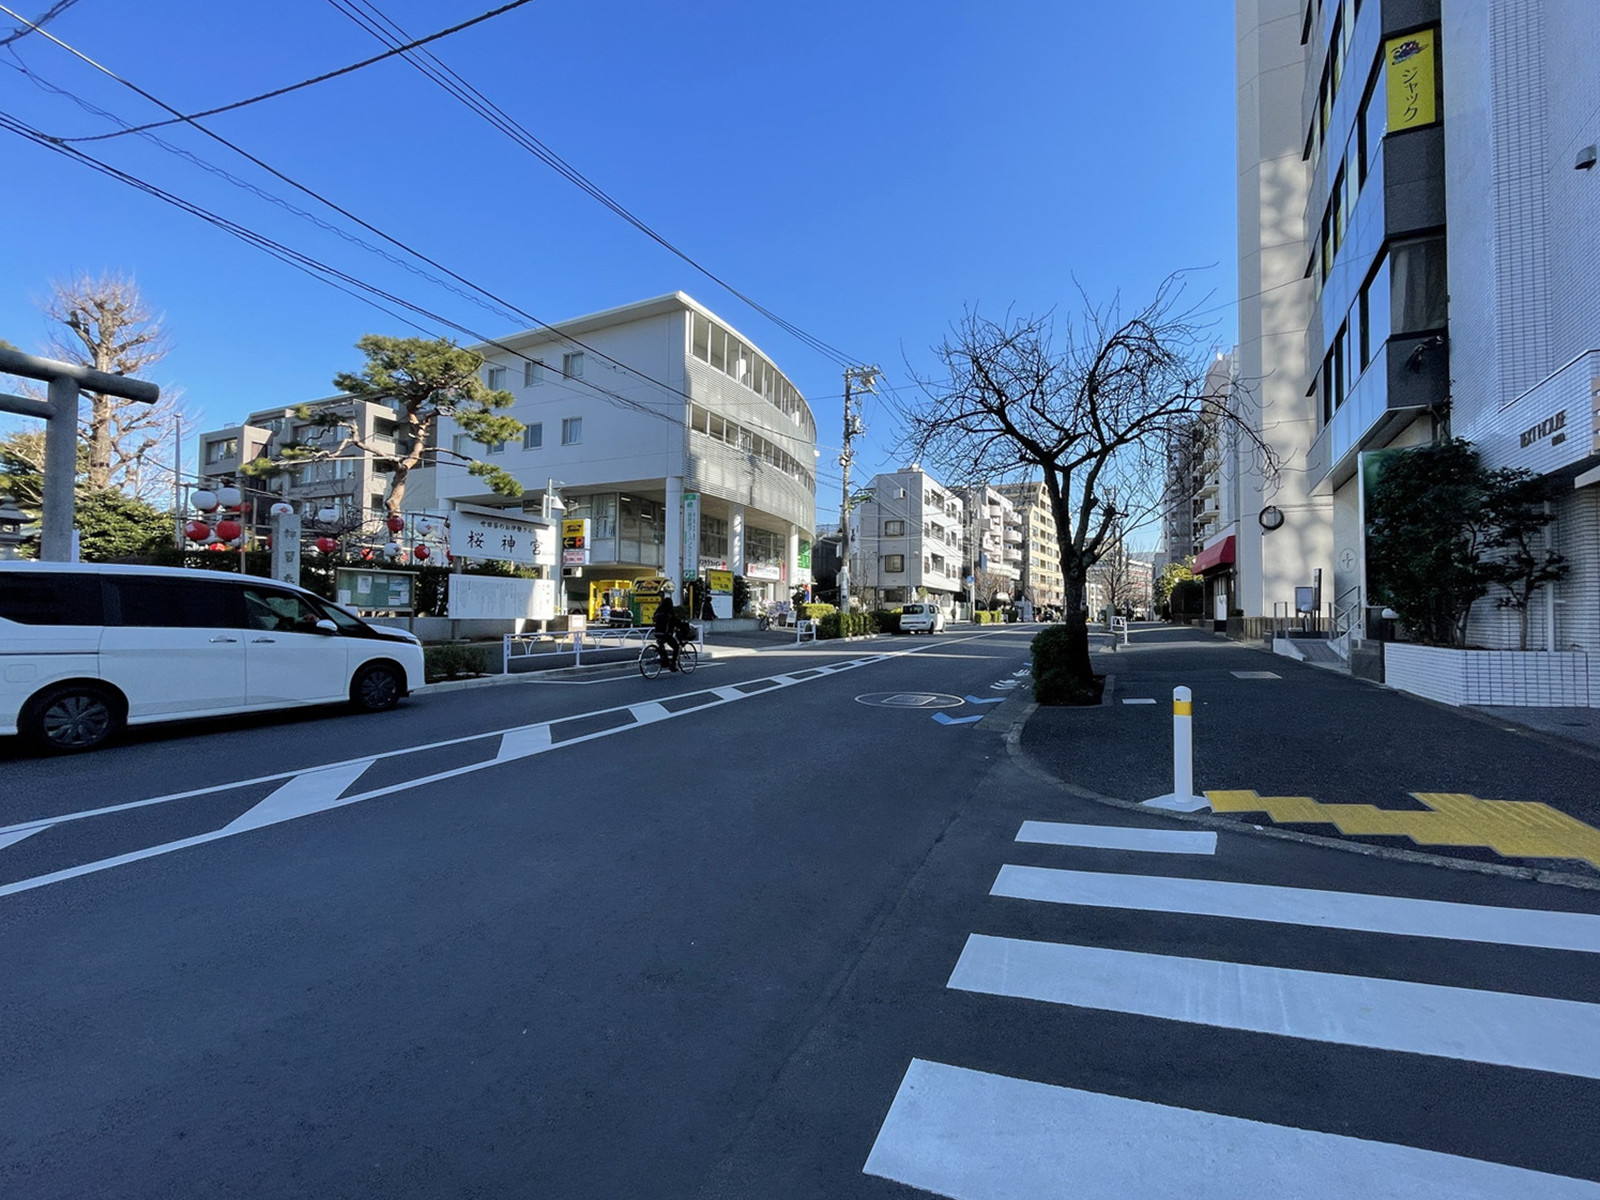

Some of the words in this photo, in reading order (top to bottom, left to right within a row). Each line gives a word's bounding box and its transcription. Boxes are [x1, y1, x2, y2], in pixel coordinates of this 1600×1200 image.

[1402, 66, 1418, 123] ジャック
[467, 530, 543, 555] 桜神宮
